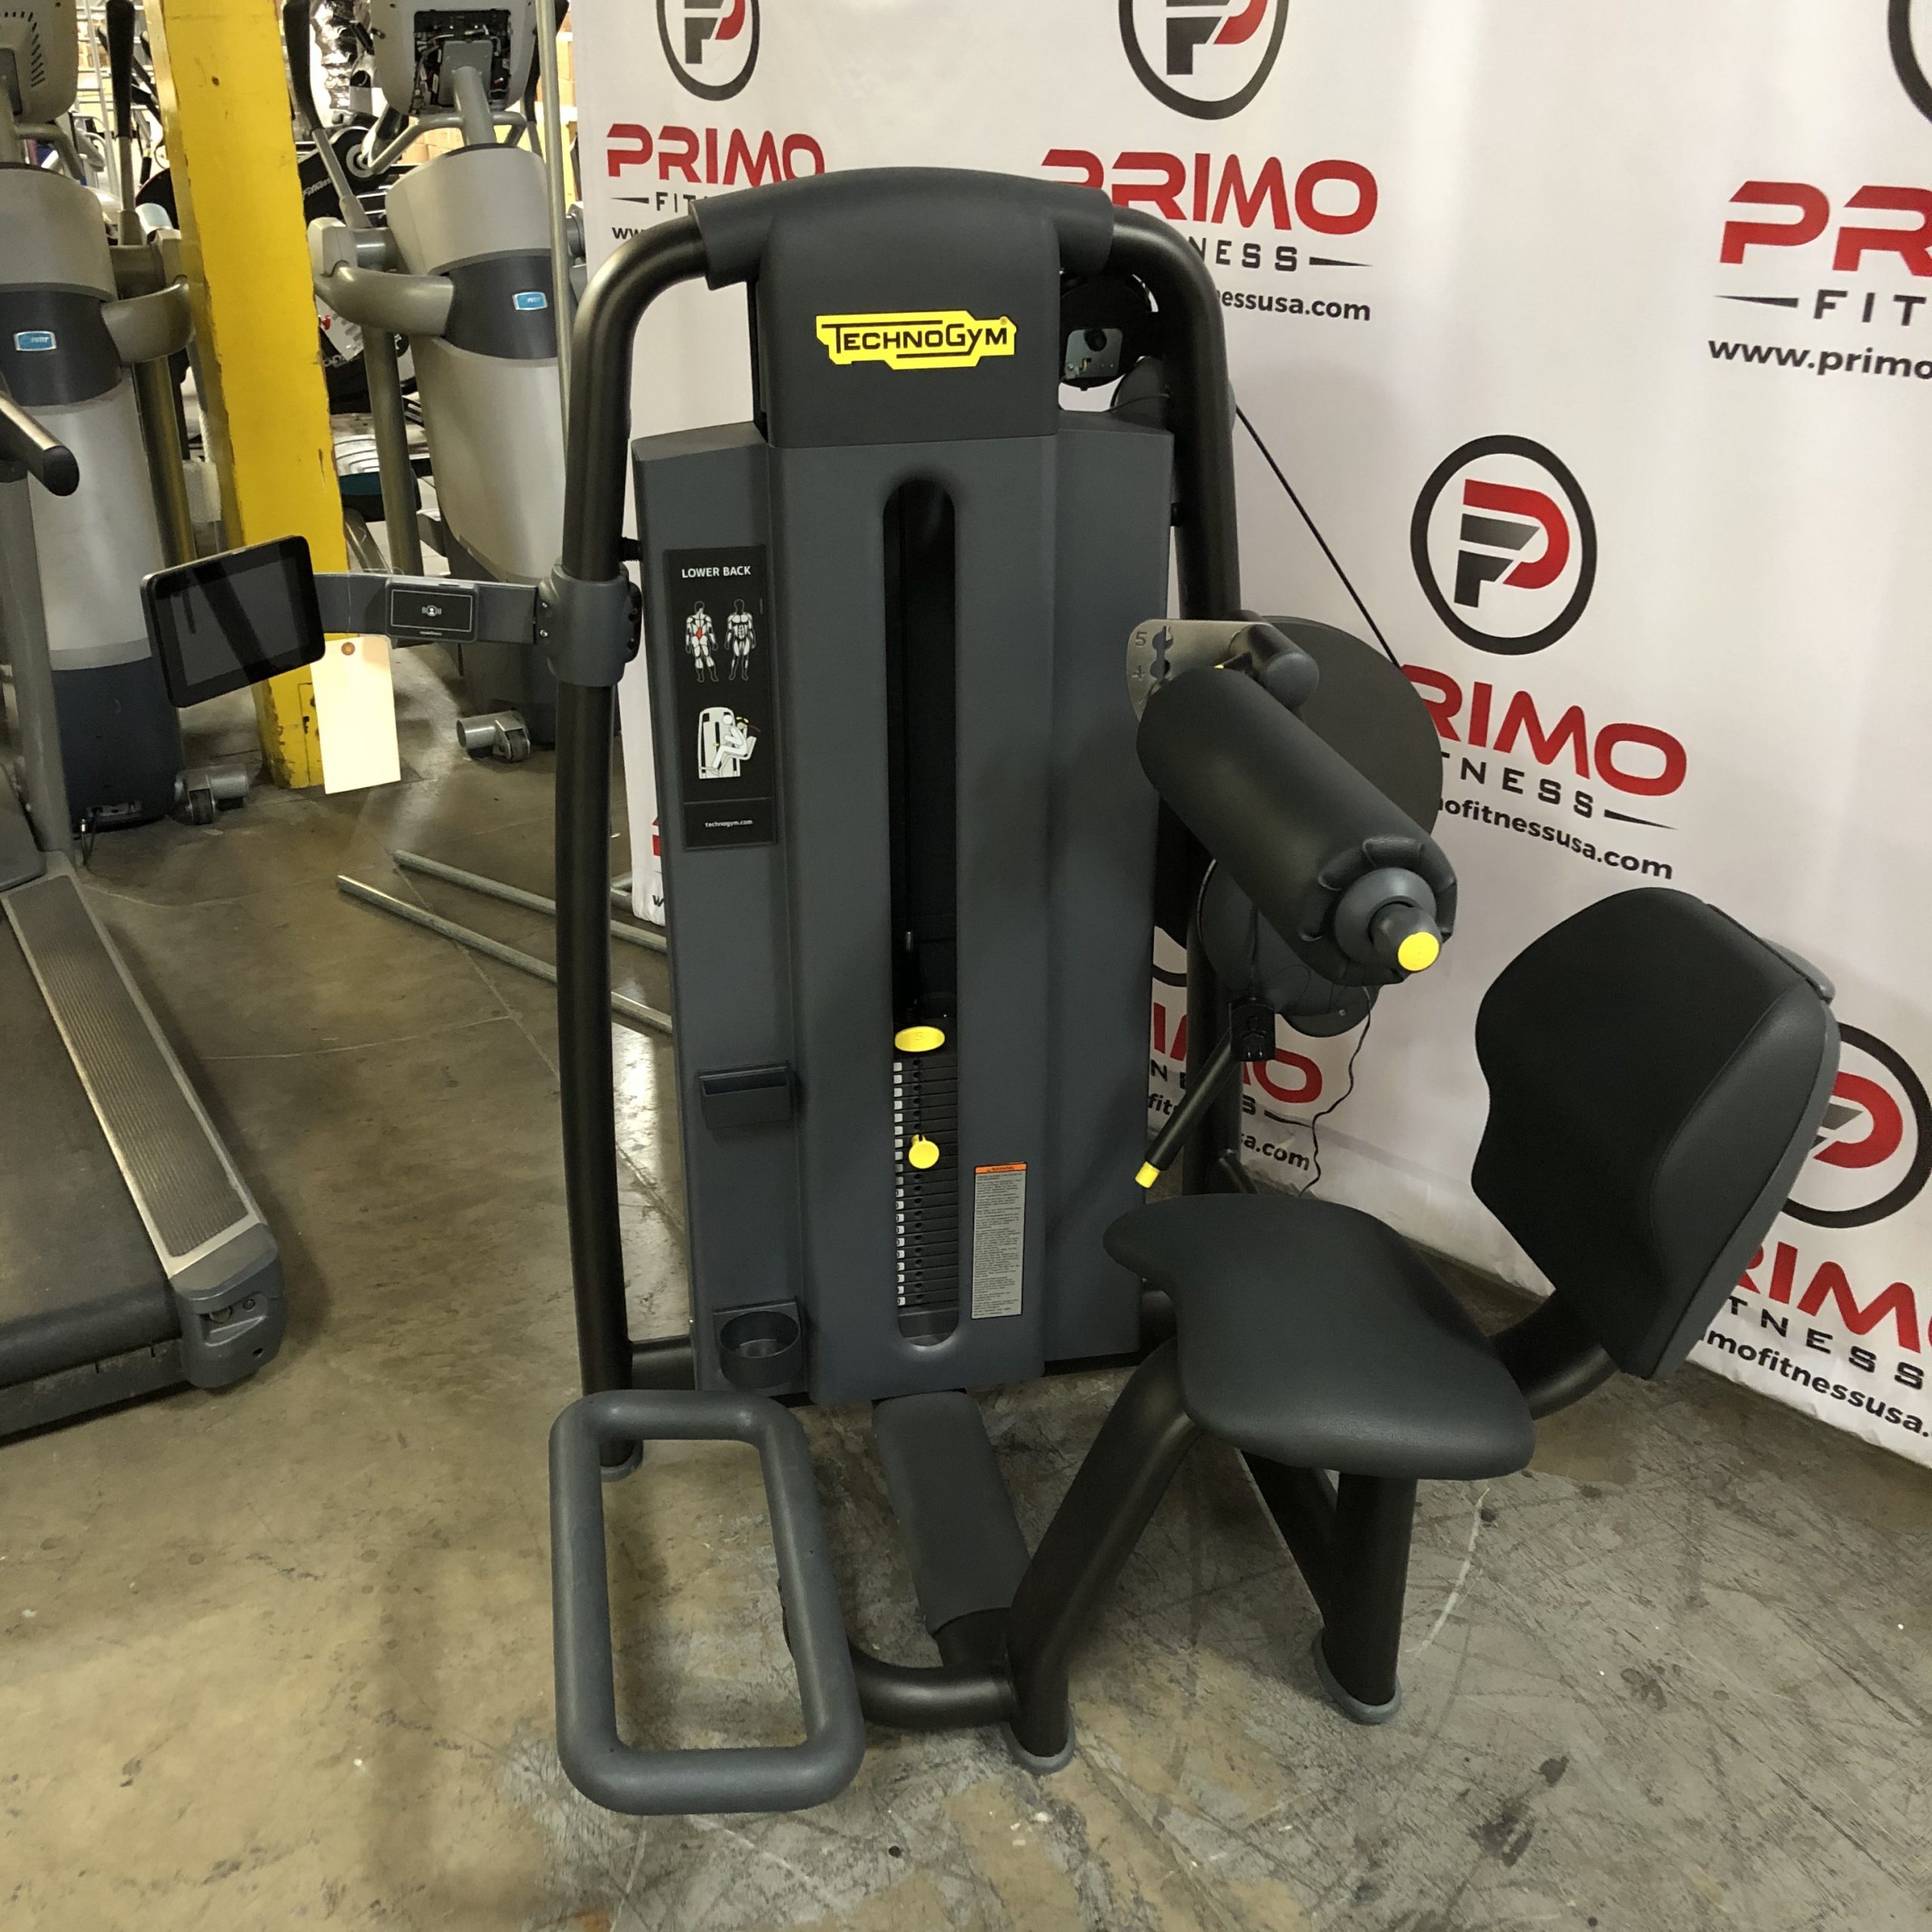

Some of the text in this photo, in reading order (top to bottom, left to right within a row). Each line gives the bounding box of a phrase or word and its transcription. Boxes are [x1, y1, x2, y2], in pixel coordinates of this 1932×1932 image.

[607, 123, 825, 187] PRIMO
[681, 565, 751, 578] LOWER BACK
[1707, 1330, 1932, 1437] mofitnessusa.
